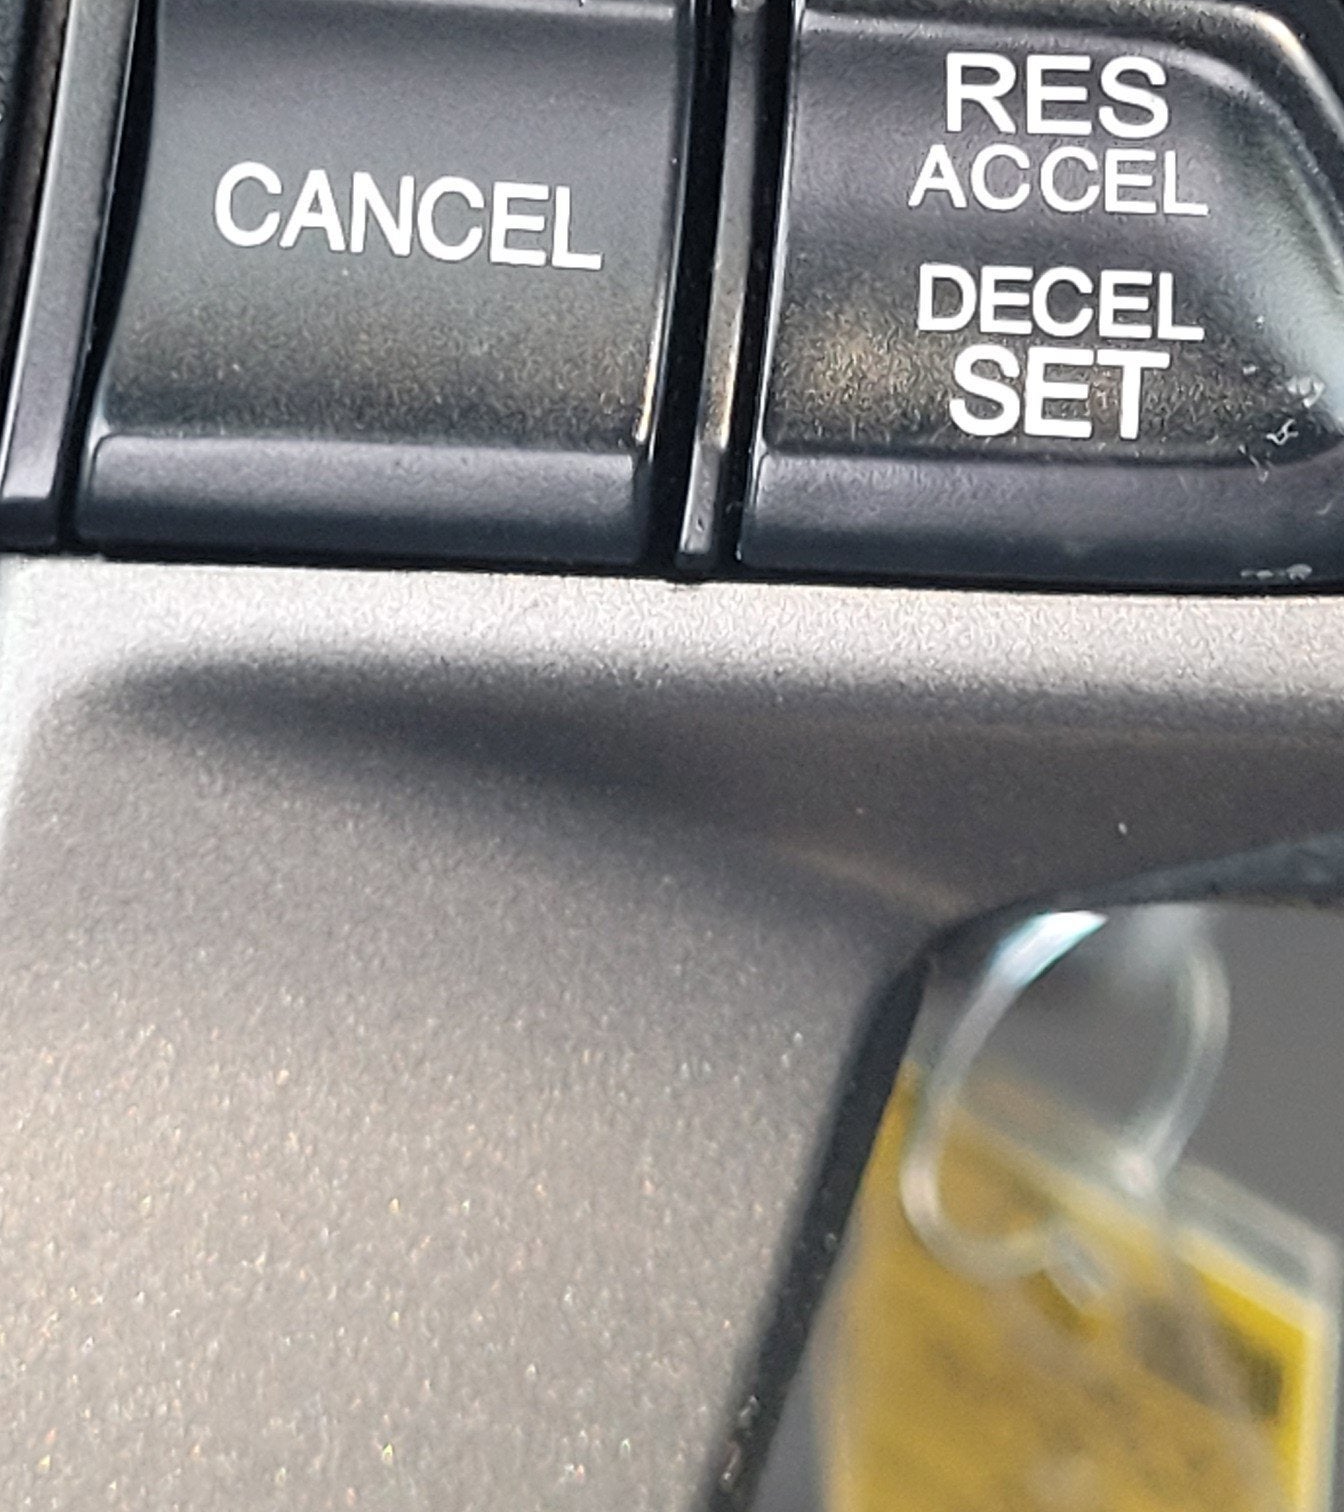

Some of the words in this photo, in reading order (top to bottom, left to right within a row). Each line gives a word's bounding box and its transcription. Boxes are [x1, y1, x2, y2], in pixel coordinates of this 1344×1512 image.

[945, 48, 1169, 139] RES
[213, 160, 603, 271] CANCEL
[907, 142, 1210, 218] ACCEL
[916, 261, 1206, 341] DECEL
[947, 345, 1171, 440] SET
